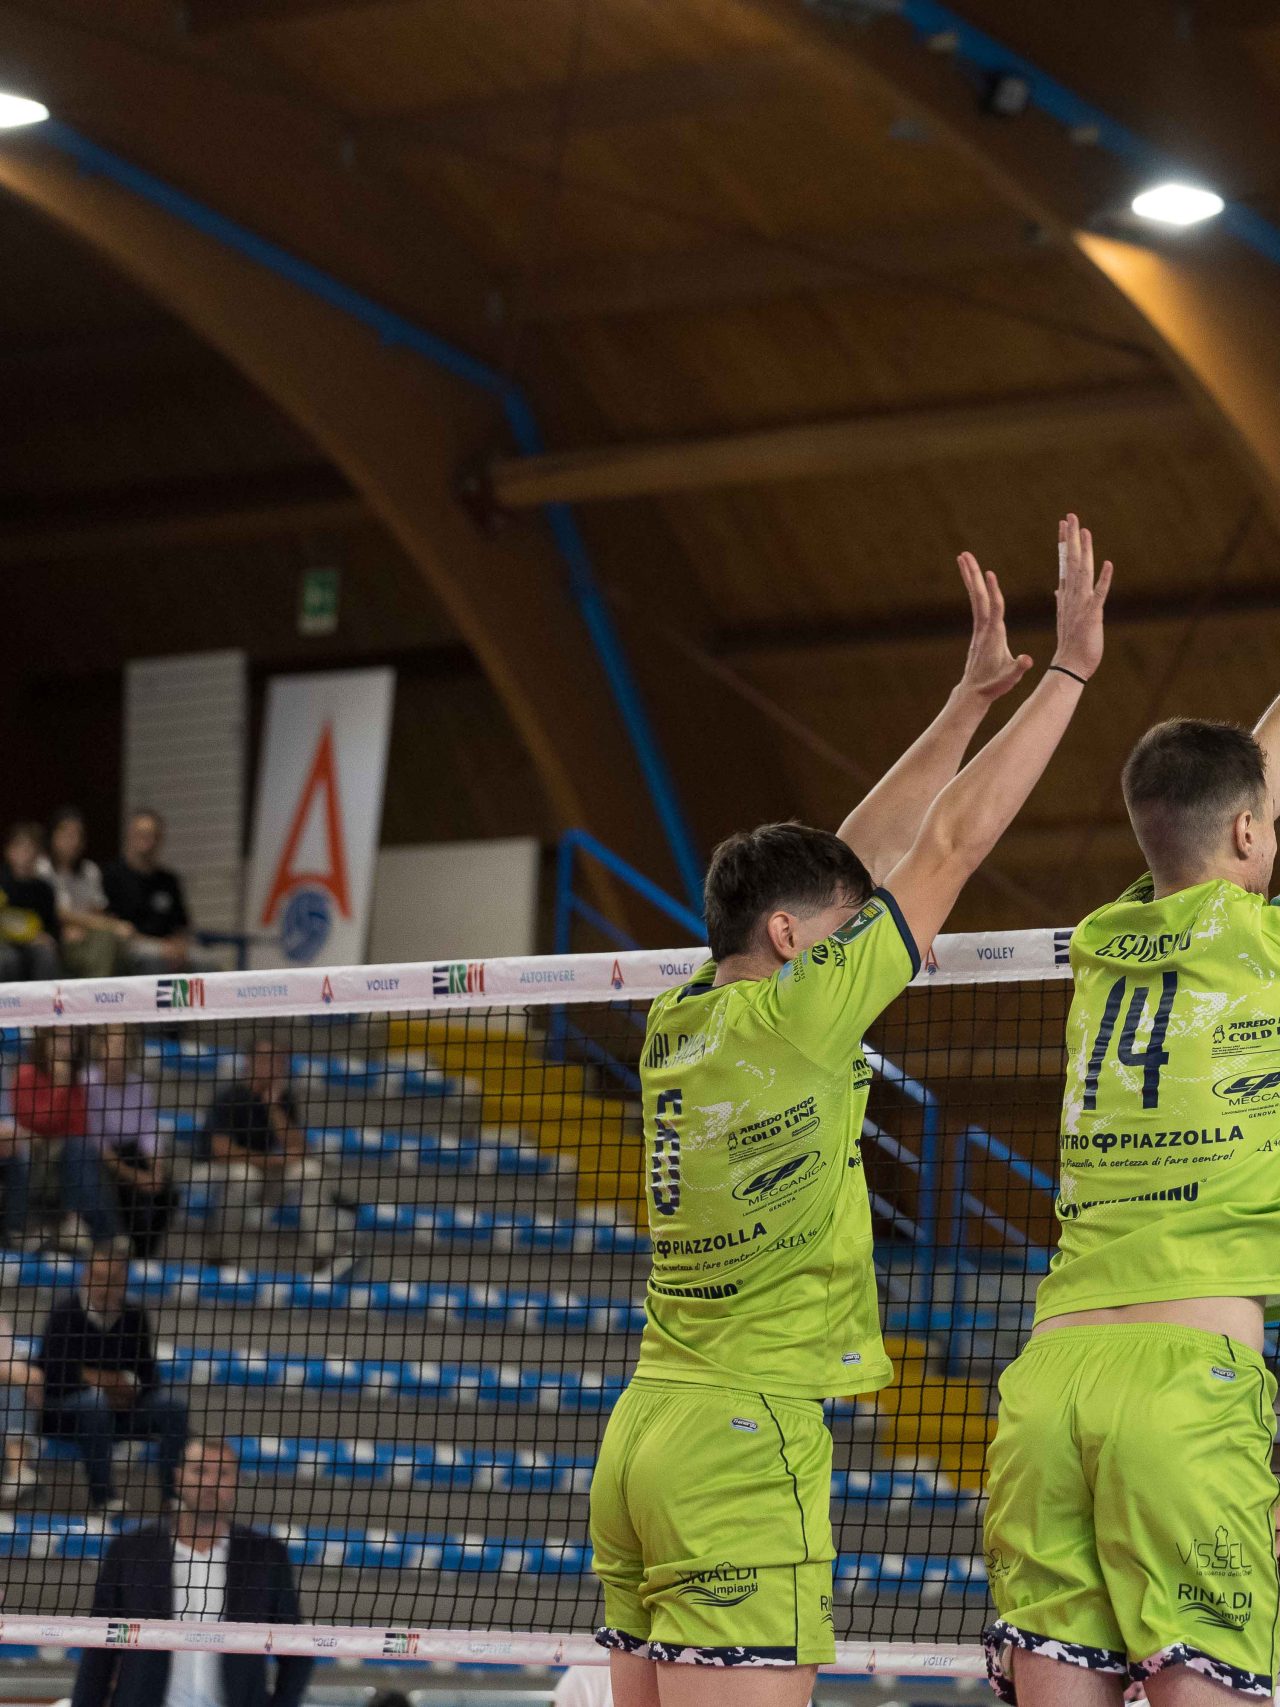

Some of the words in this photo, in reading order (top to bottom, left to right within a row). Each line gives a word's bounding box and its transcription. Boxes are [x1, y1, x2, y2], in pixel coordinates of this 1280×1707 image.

[977, 946, 1015, 961] VOLLEY
[366, 978, 400, 991] VOLLEY
[520, 969, 576, 984] ALTOTEVERE
[659, 963, 695, 976] VOLLEY
[1228, 1018, 1275, 1030] ARREDO
[1083, 970, 1178, 1110] 14
[1228, 1029, 1273, 1042] COLD
[739, 1113, 782, 1135] ARREDO
[784, 1096, 815, 1118] FRIGO
[1248, 1110, 1276, 1119] GENOVA
[741, 1125, 782, 1145] COLD
[784, 1104, 818, 1129] LINE
[1060, 1134, 1088, 1149] NTRO
[1120, 1125, 1244, 1149] PIAZZOLLA
[1098, 1157, 1107, 1168] la
[1110, 1158, 1148, 1168] certezza
[1152, 1156, 1161, 1166] di
[1163, 1156, 1188, 1167] fare
[1192, 1149, 1235, 1164] centro!
[748, 1161, 827, 1206] MECCANICA
[768, 1197, 796, 1212] GENOVA
[673, 1222, 768, 1255] PIAZZOLLA
[702, 1261, 721, 1272] fare
[714, 1582, 758, 1595] impianti
[1178, 1583, 1252, 1609] RINADI
[923, 1656, 954, 1667] VOLLEY
